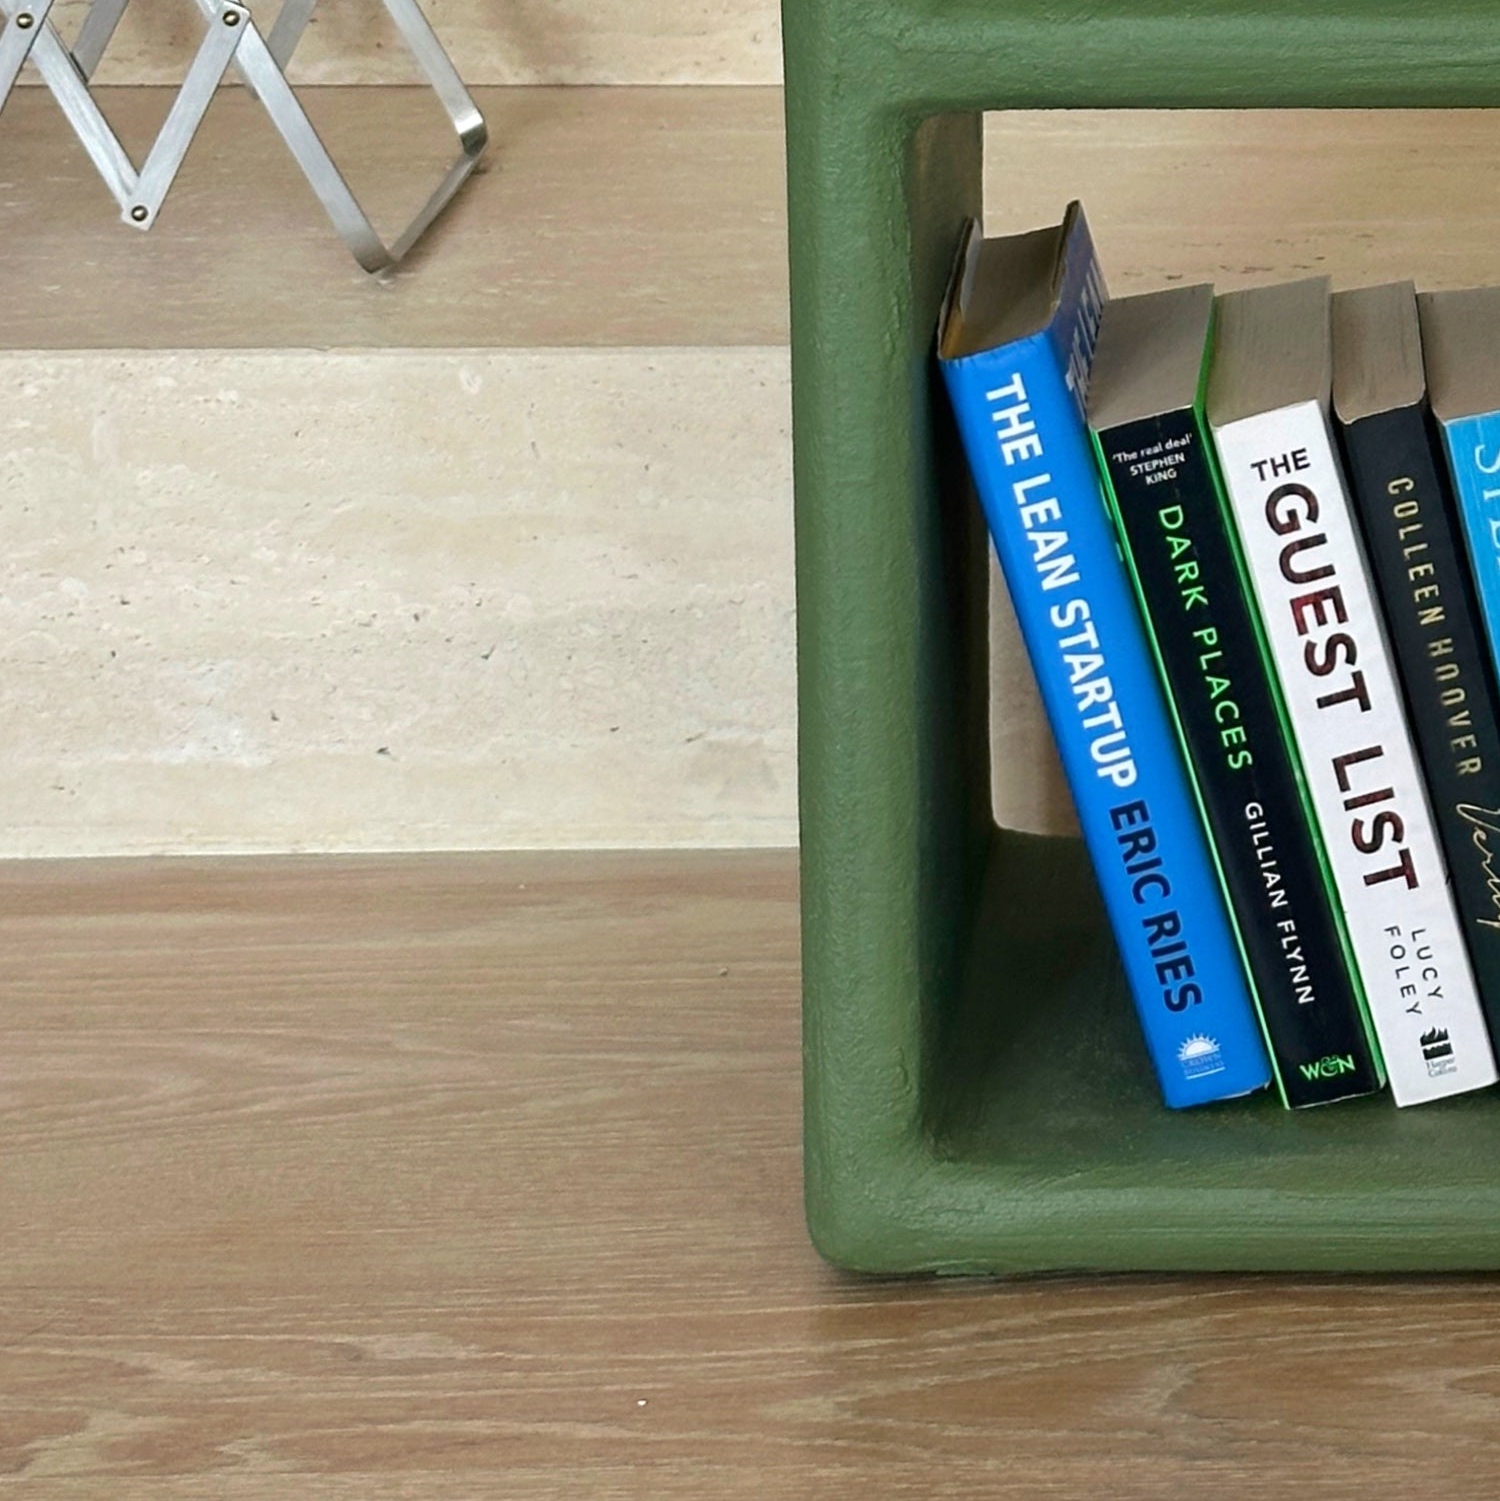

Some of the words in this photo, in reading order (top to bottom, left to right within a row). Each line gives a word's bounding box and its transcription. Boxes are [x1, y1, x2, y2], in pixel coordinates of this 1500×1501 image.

[986, 373, 1043, 465] THE
[1129, 452, 1186, 476] STEPHEN
[1140, 443, 1163, 457] real
[1251, 448, 1311, 481] THE
[1145, 468, 1178, 485] KING
[1013, 474, 1081, 591] LEAN
[1159, 505, 1208, 610] DARK
[1193, 627, 1253, 770] PLACES
[1388, 477, 1445, 625] COLLEEN
[1428, 638, 1482, 775] HOOVER
[1051, 599, 1138, 788] STARTUP
[1265, 483, 1372, 713] GUEST
[1332, 745, 1419, 889] LIST
[1109, 799, 1171, 905] ERIC
[1142, 910, 1202, 1013] RIES
[1245, 802, 1290, 908] GILLIAN
[1277, 919, 1315, 1005] FLYNN
[1384, 925, 1422, 1016] FOLEY
[1410, 928, 1444, 999] LUCY
[1299, 1054, 1356, 1080] W&N
